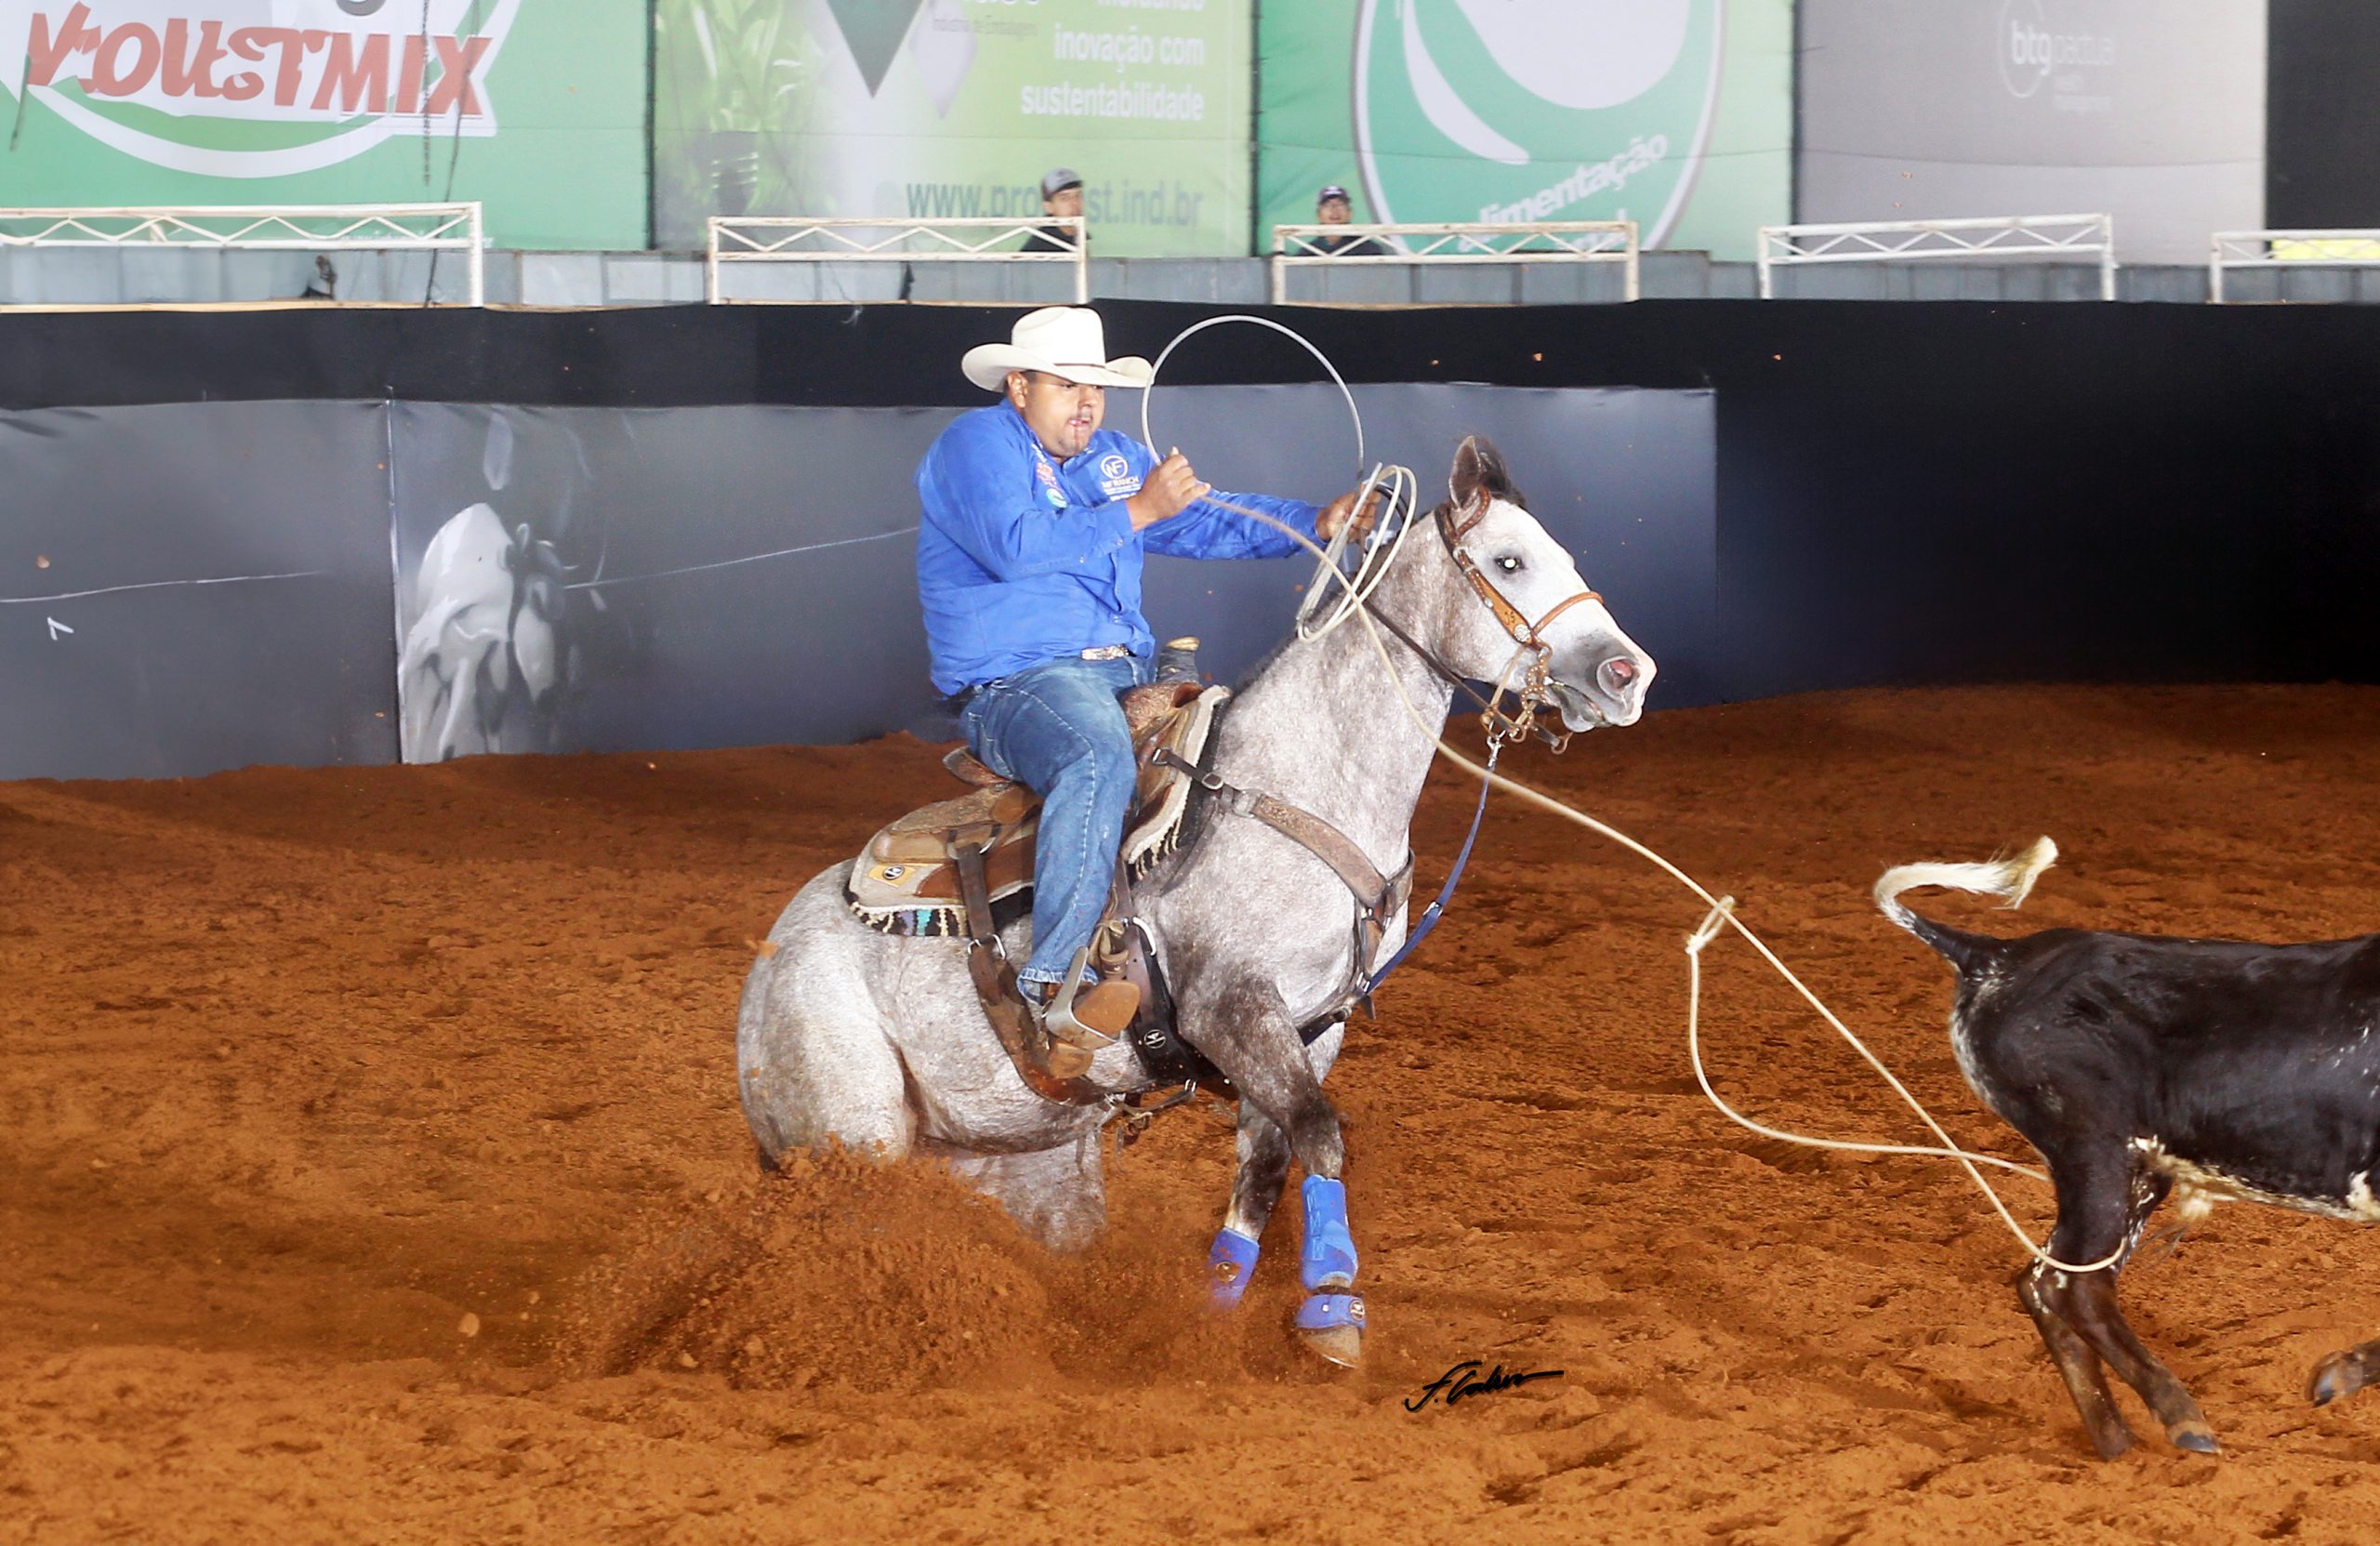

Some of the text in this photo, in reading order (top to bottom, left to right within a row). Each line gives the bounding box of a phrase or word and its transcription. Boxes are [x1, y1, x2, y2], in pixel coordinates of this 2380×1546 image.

[1054, 23, 1154, 73] inovação
[1159, 36, 1206, 65] com
[2010, 20, 2051, 76] btg
[1021, 82, 1205, 121] sustentabilidade
